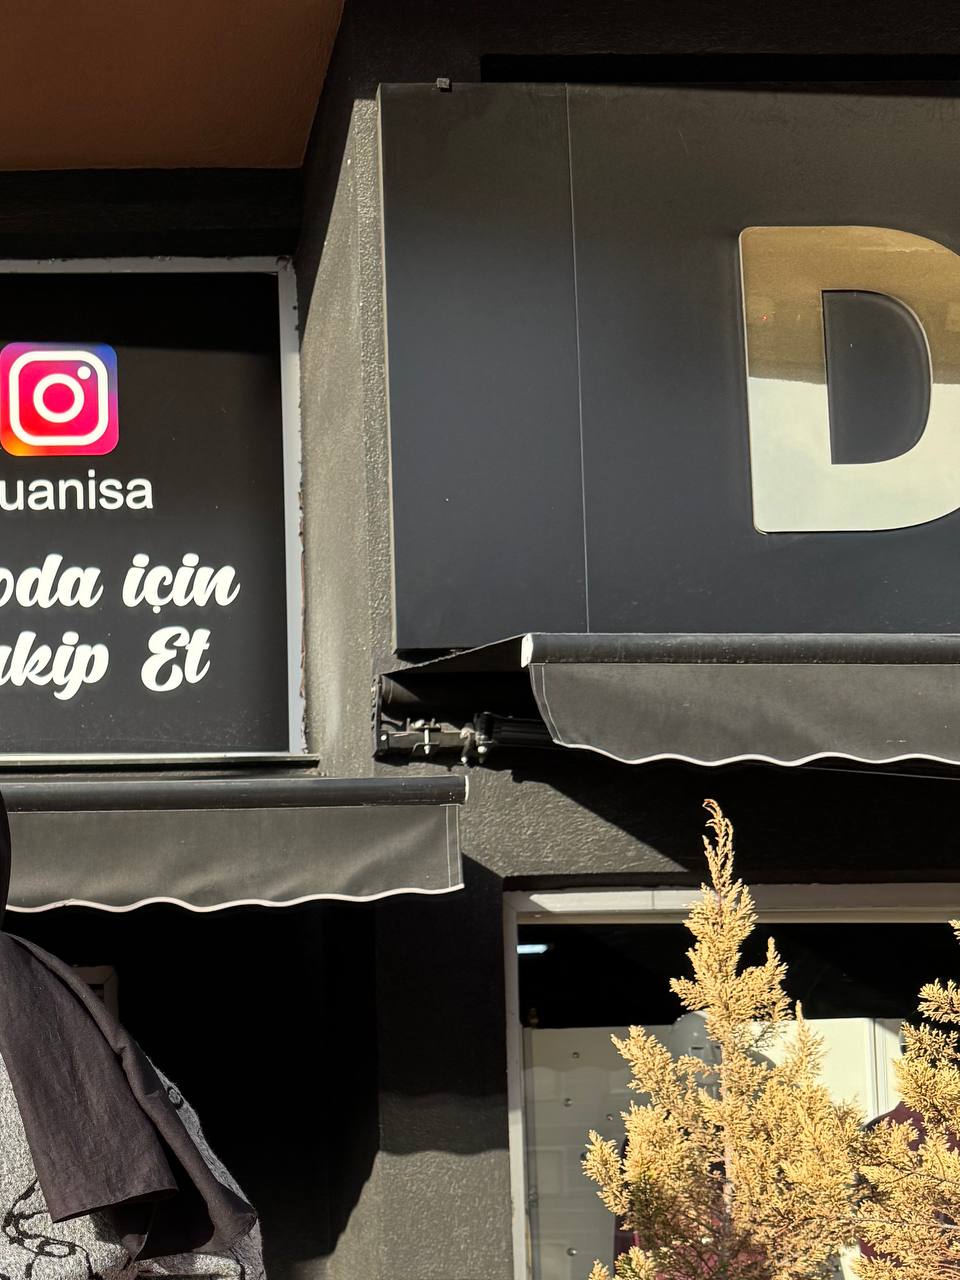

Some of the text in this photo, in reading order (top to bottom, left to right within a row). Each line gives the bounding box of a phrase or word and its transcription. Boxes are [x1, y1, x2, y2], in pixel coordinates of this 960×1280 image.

[738, 226, 960, 533] D
[121, 552, 241, 614] için
[140, 625, 211, 692] Et
